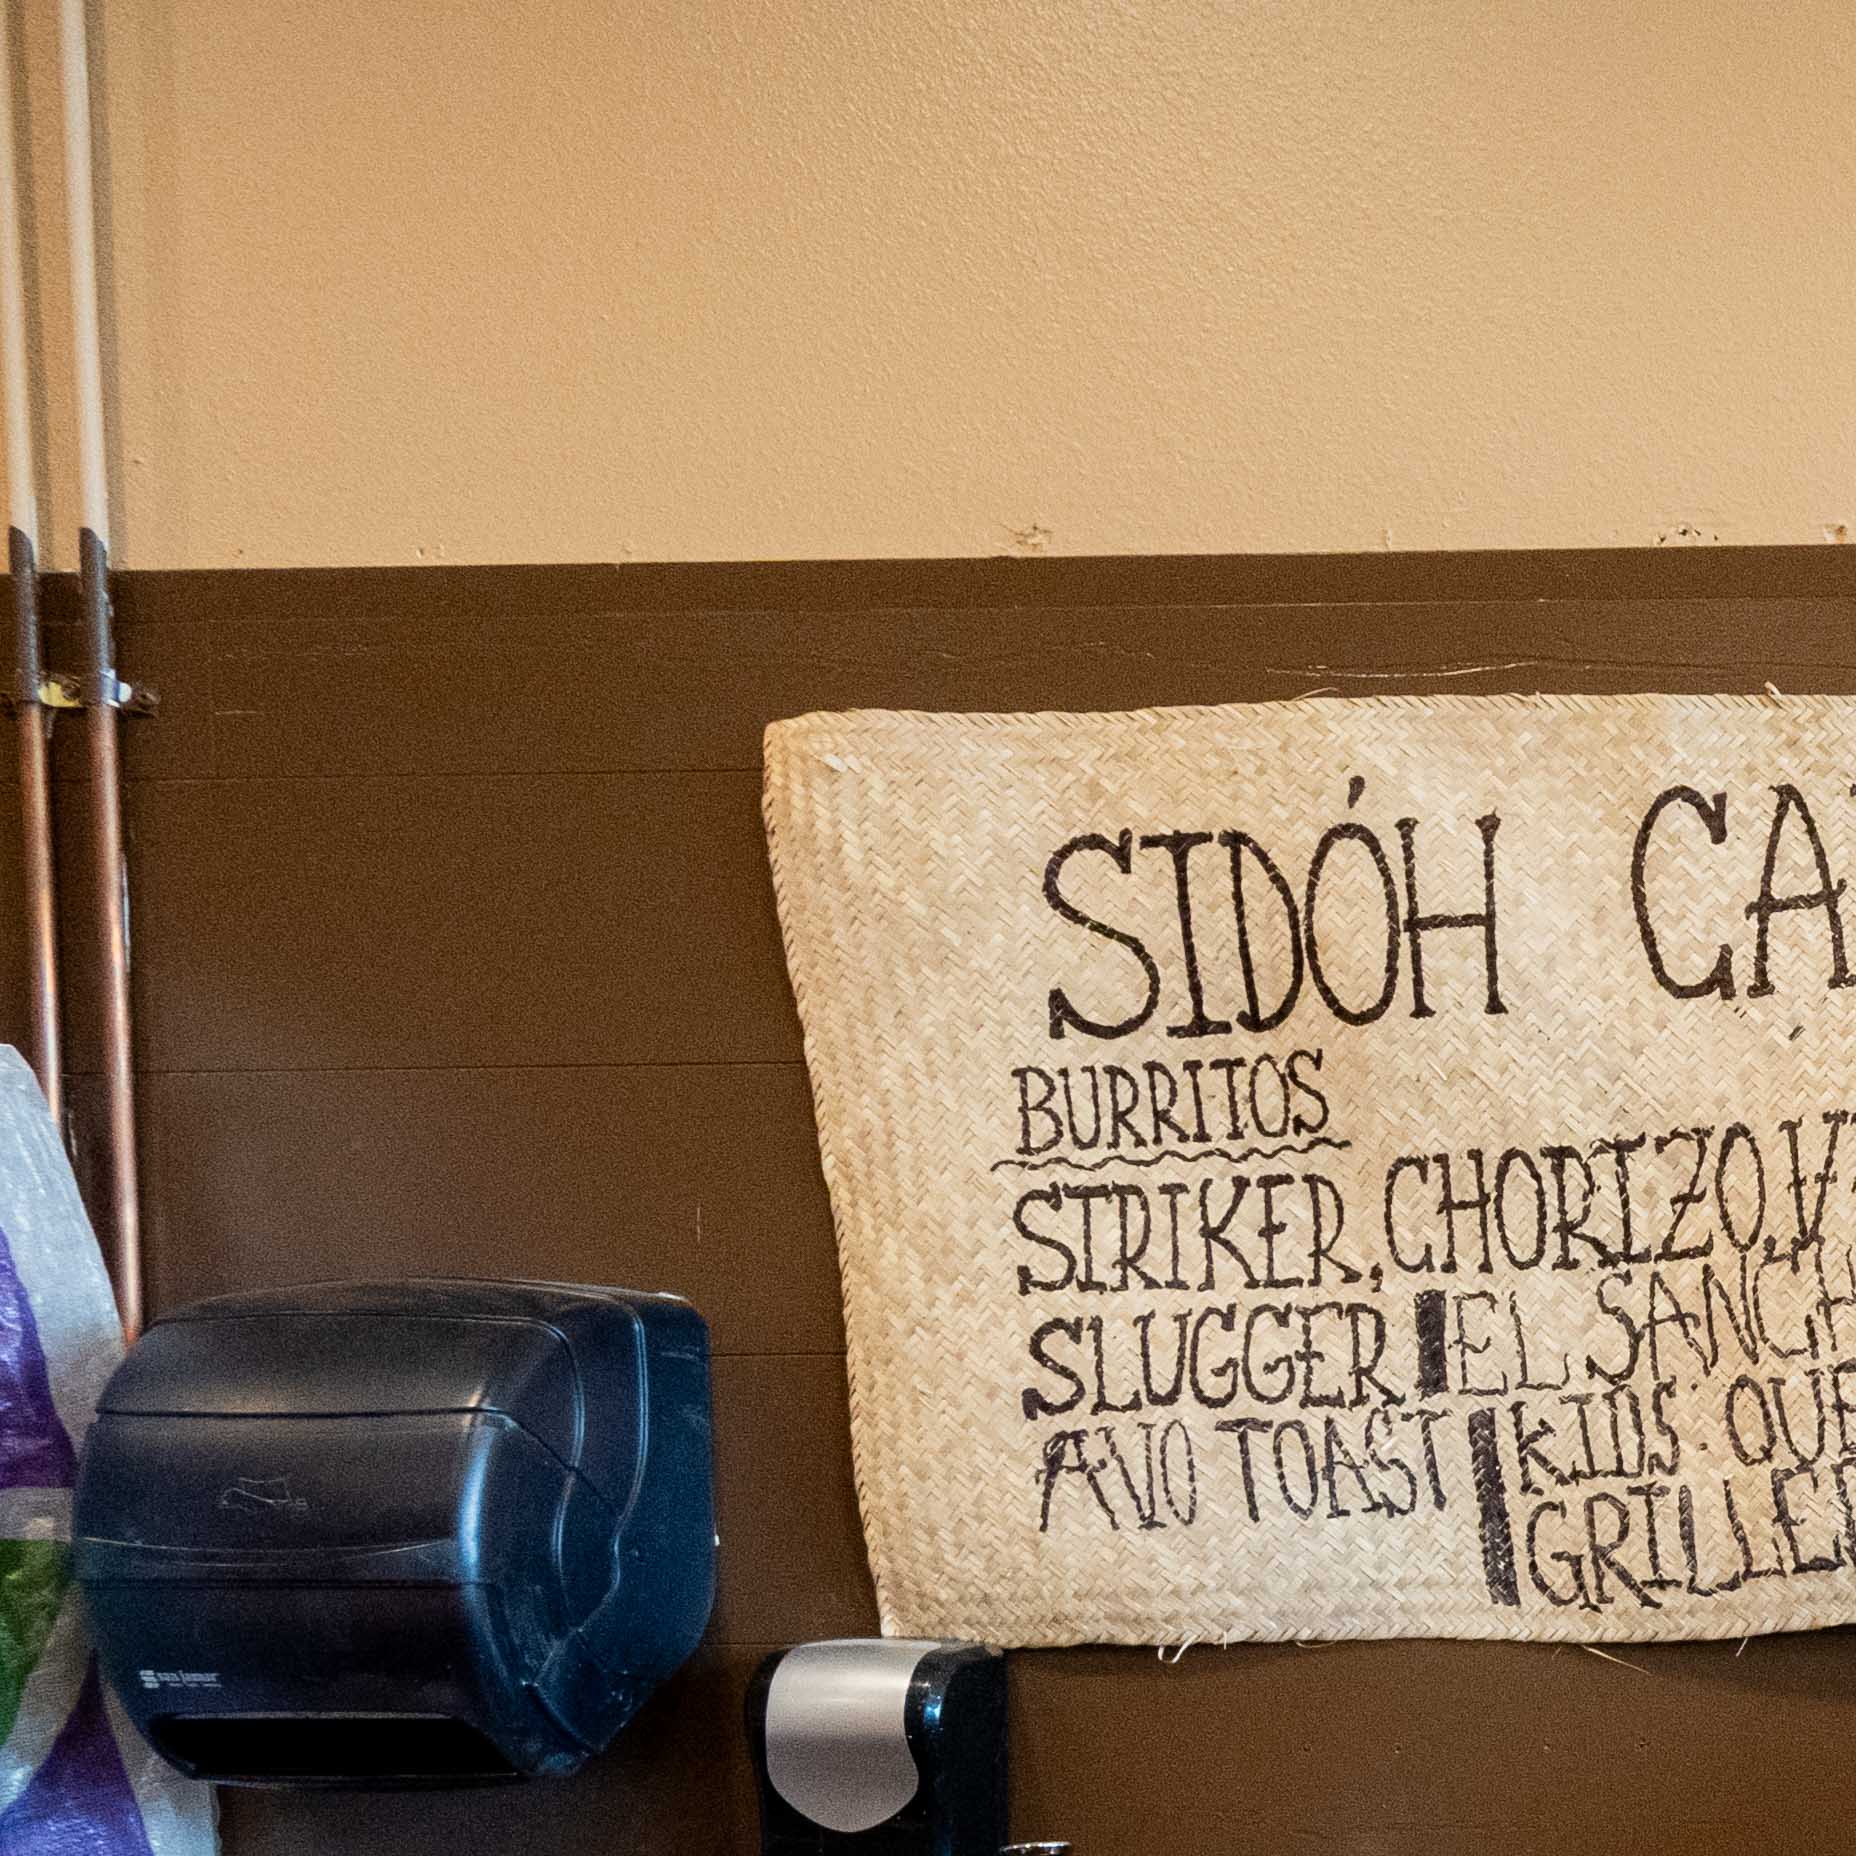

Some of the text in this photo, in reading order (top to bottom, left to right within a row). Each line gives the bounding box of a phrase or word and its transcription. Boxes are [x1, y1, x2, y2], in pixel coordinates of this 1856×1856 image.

[1042, 775, 1509, 1039] SIDÓH
[1011, 1049, 1329, 1156] BURRITOS
[1022, 1303, 1405, 1420] SLUGGER
[1452, 1290, 1570, 1396] EL
[1035, 1407, 1451, 1532] AVO TOAST
